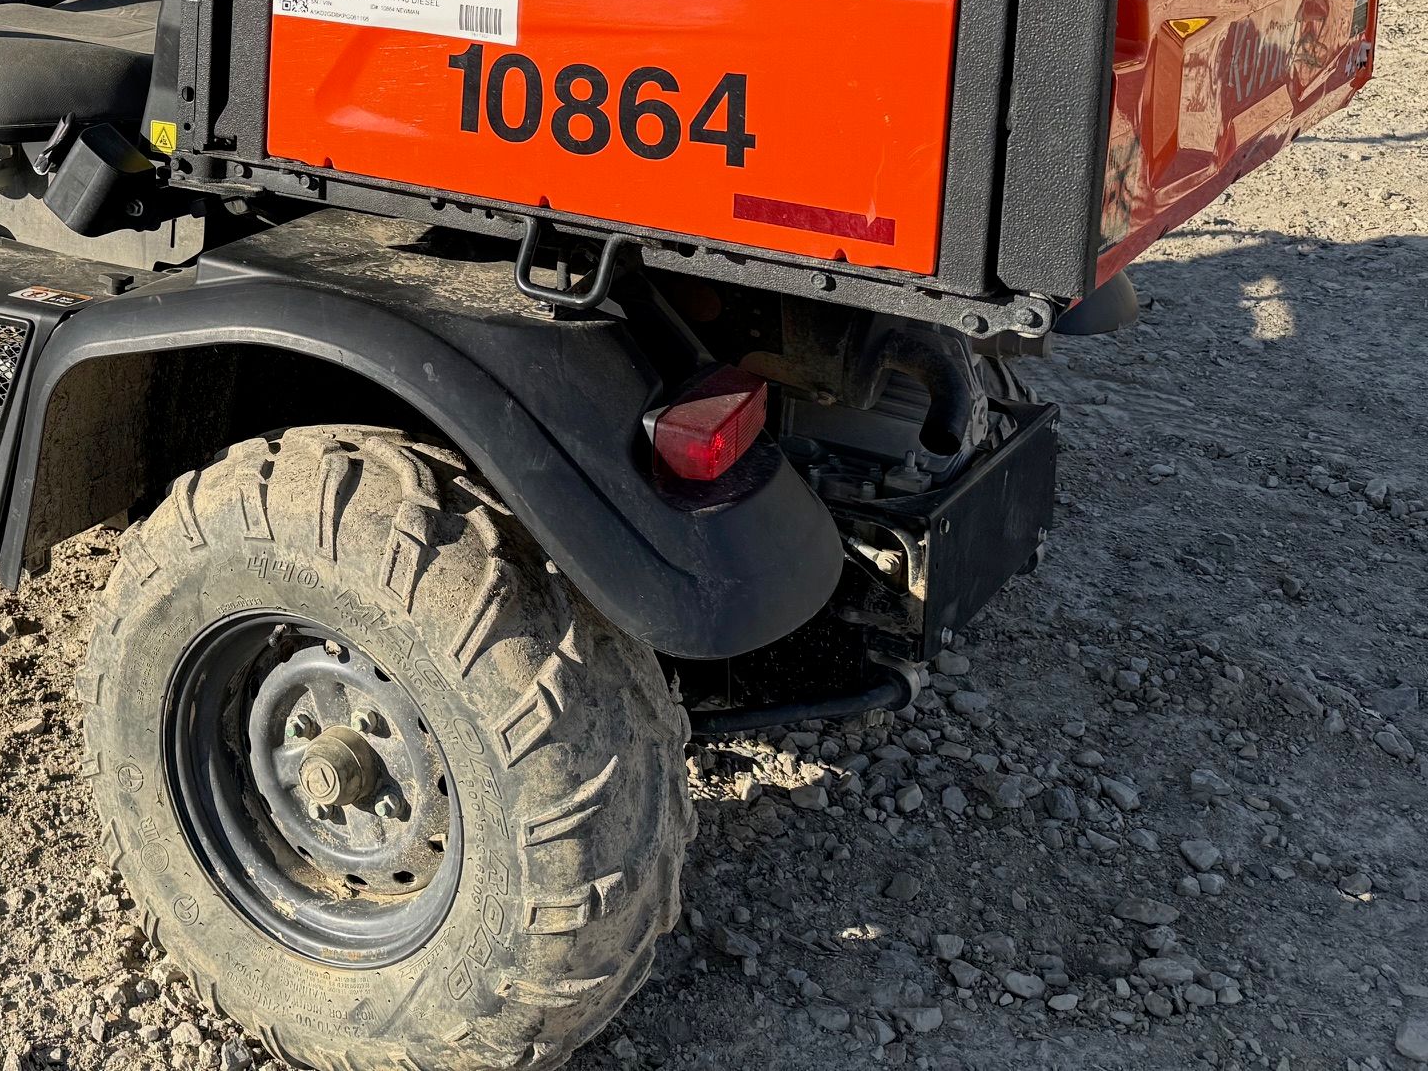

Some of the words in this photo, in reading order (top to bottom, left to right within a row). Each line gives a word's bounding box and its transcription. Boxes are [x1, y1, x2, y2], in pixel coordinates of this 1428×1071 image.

[447, 43, 756, 168] 10864
[335, 588, 452, 693] MAG
[374, 635, 431, 698] SERVICE
[453, 717, 510, 840] OFF
[446, 850, 510, 1001] ROAD
[329, 1008, 348, 1019] FOR
